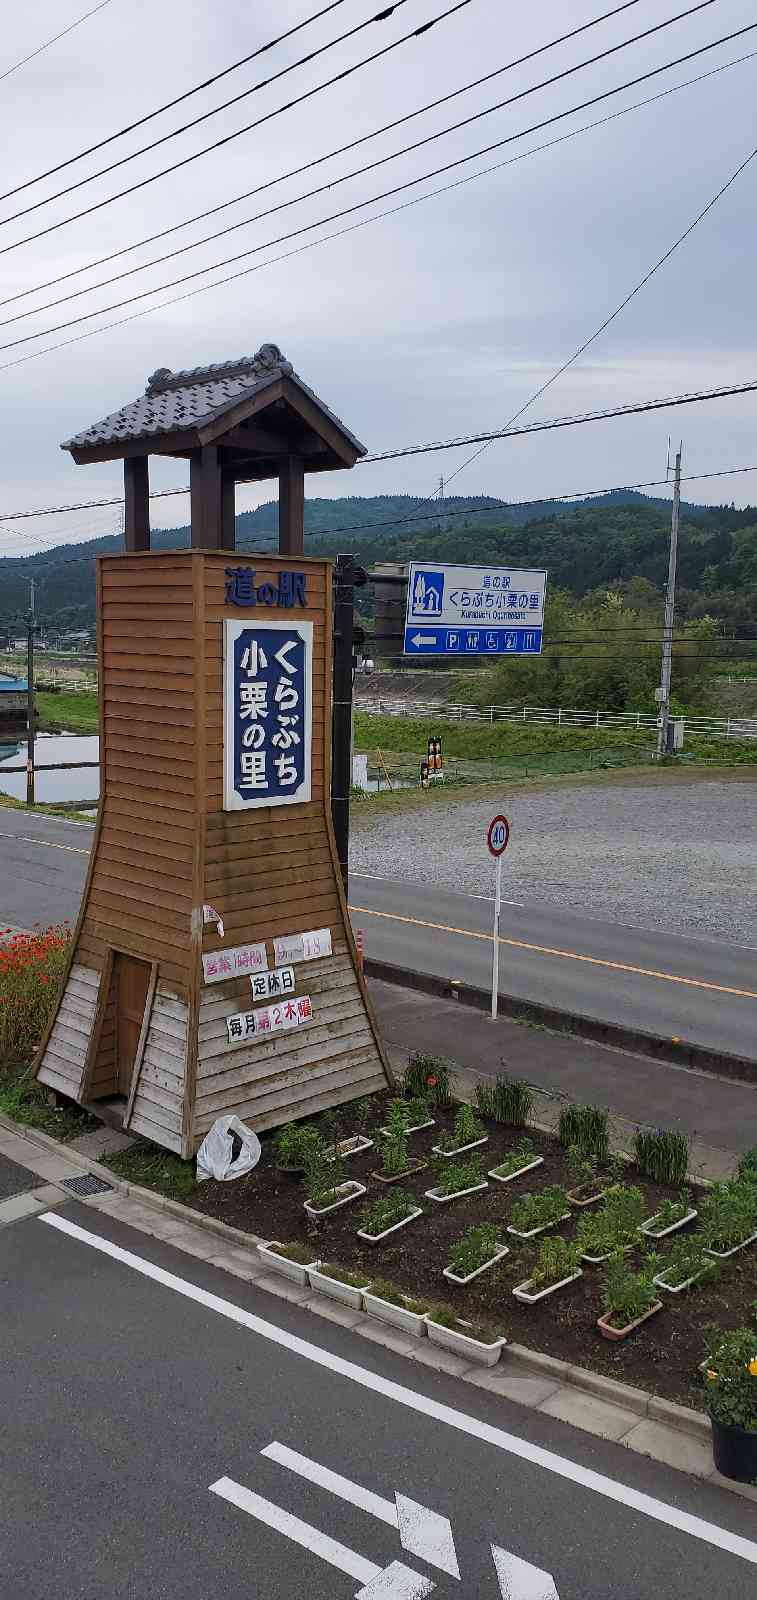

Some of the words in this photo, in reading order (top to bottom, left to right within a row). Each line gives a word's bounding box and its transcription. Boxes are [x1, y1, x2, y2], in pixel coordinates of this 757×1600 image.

[225, 567, 308, 609] 道の駅
[482, 576, 511, 589] 道の駅
[449, 591, 540, 609] くらぶち小栗の里
[240, 640, 270, 790] 小栗の里
[272, 640, 300, 786] くらぶち
[493, 826, 505, 845] 40
[253, 970, 293, 996] 定休日
